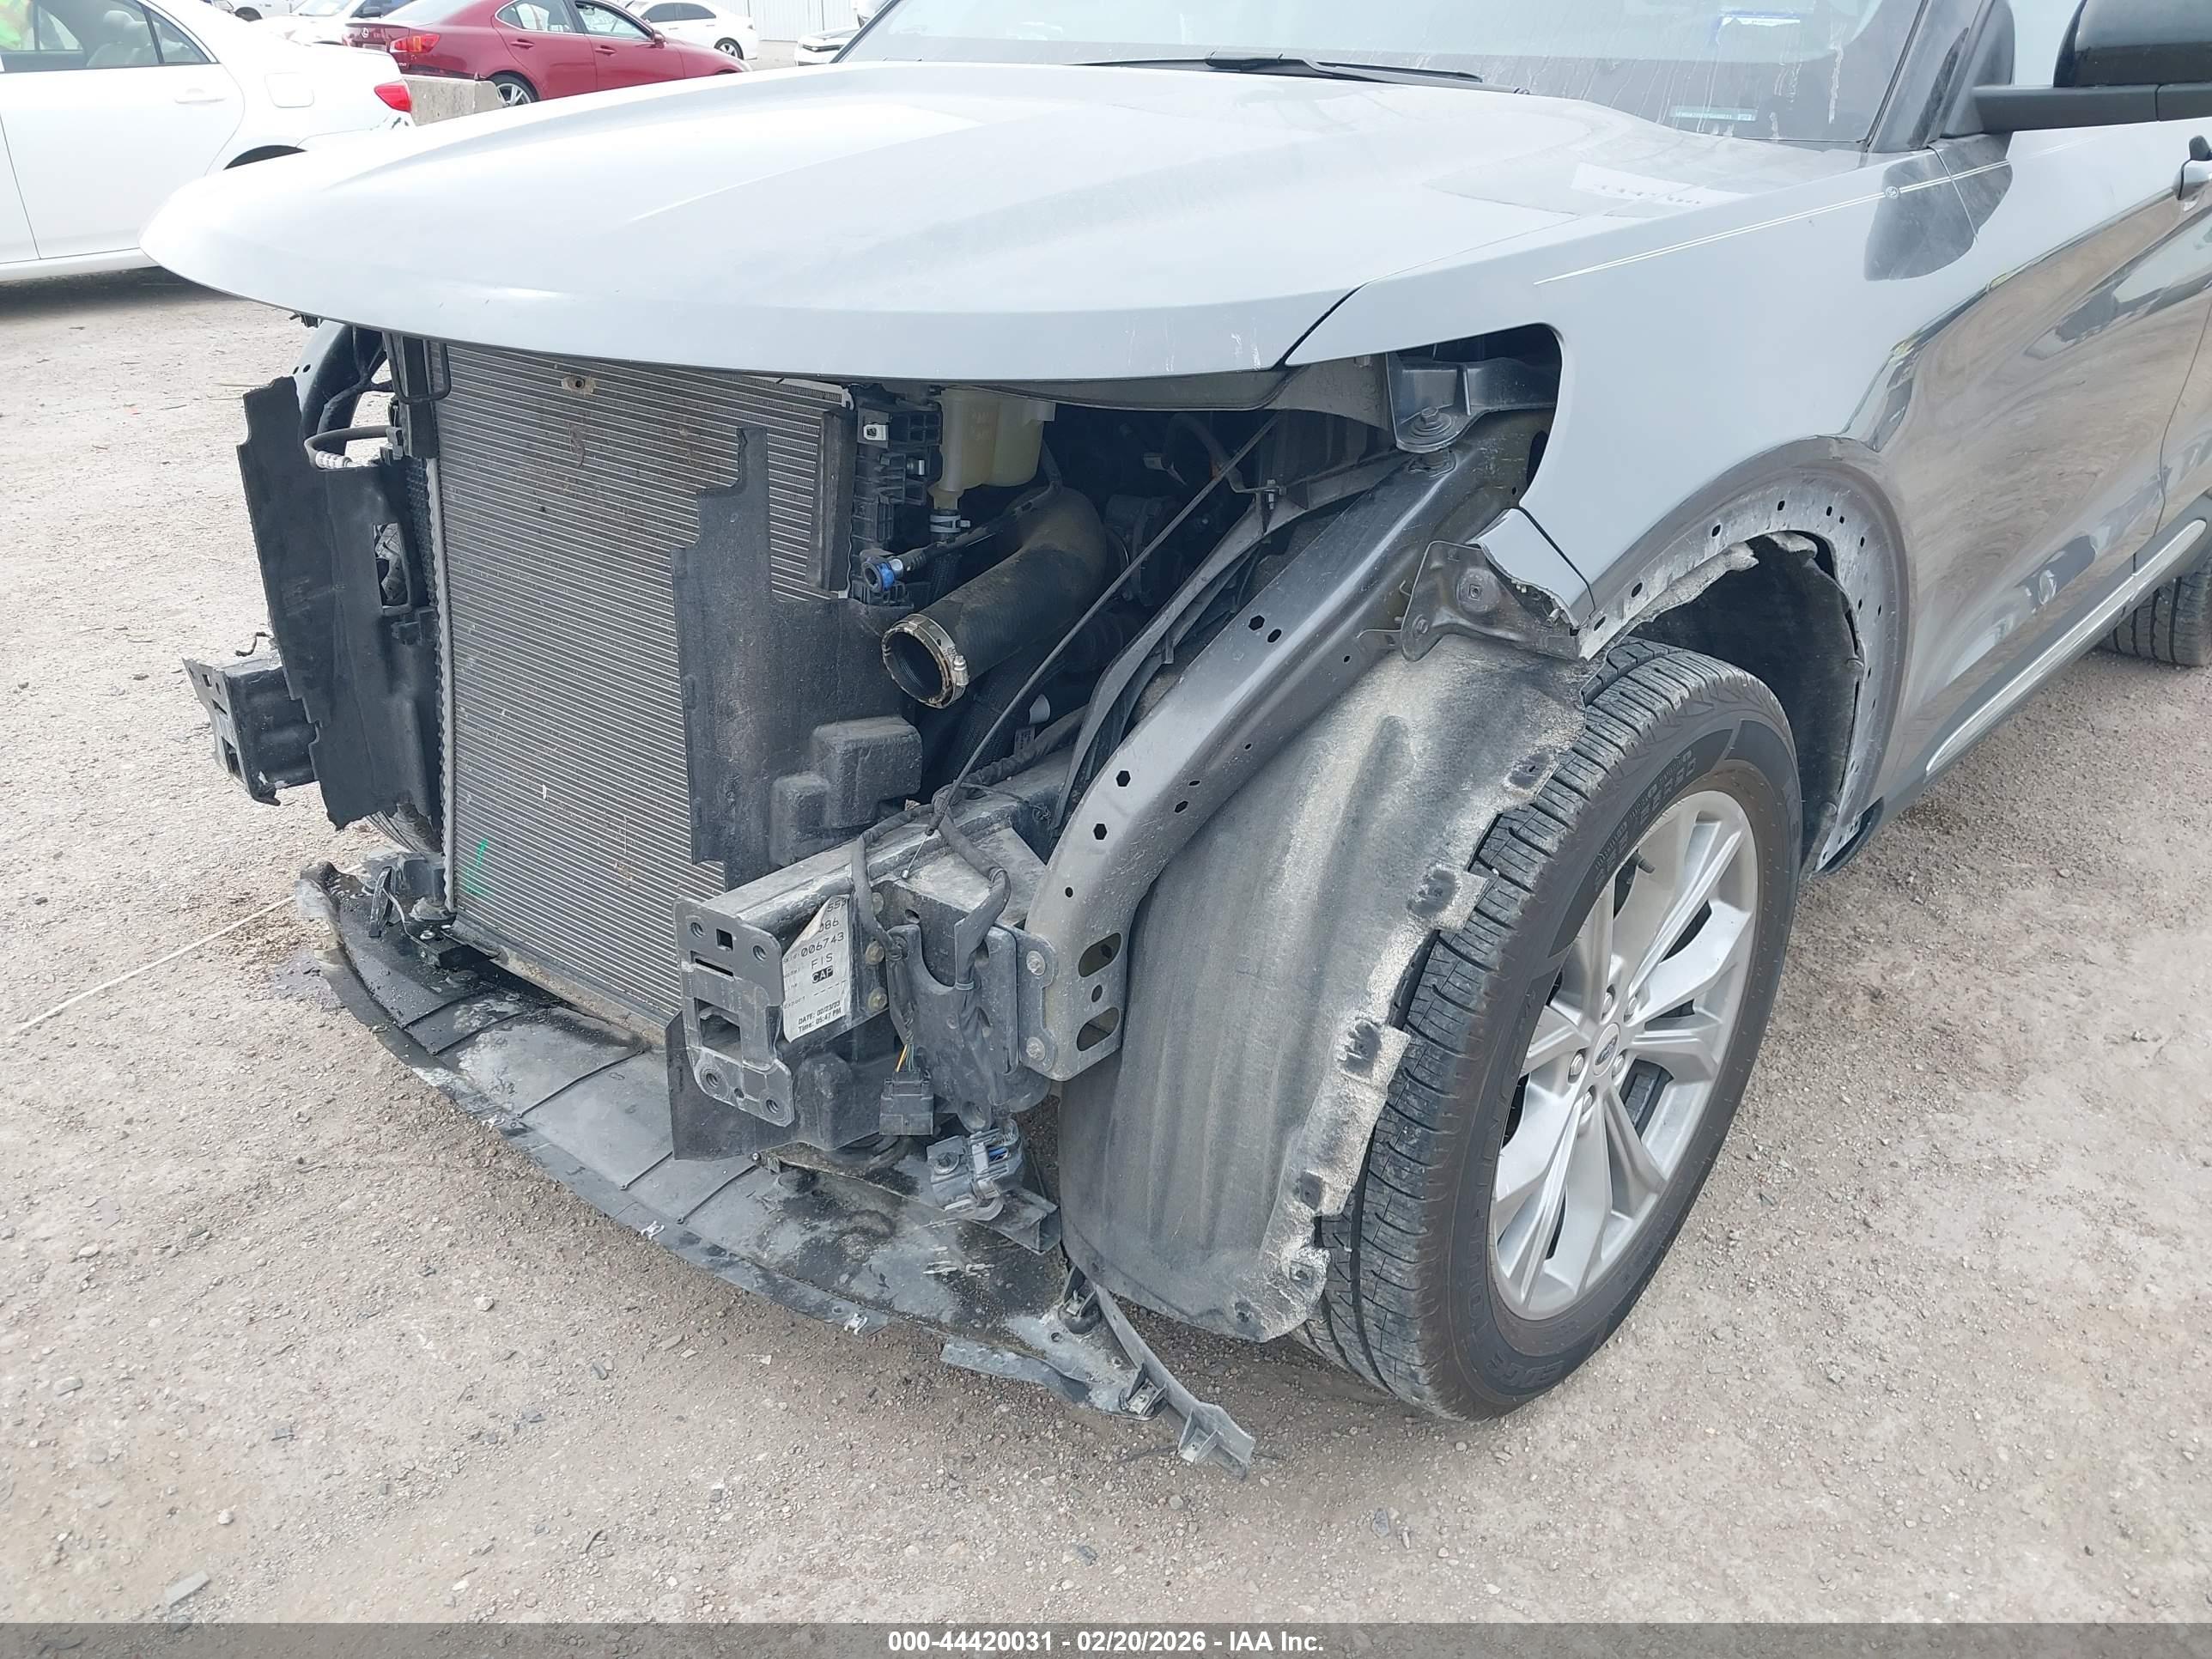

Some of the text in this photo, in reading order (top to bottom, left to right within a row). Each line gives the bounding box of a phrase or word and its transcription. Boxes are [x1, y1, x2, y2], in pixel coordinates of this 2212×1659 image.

[800, 932, 844, 957] 006743
[811, 952, 833, 969] FIS
[812, 965, 834, 984] CAP
[832, 1006, 842, 1018] PM
